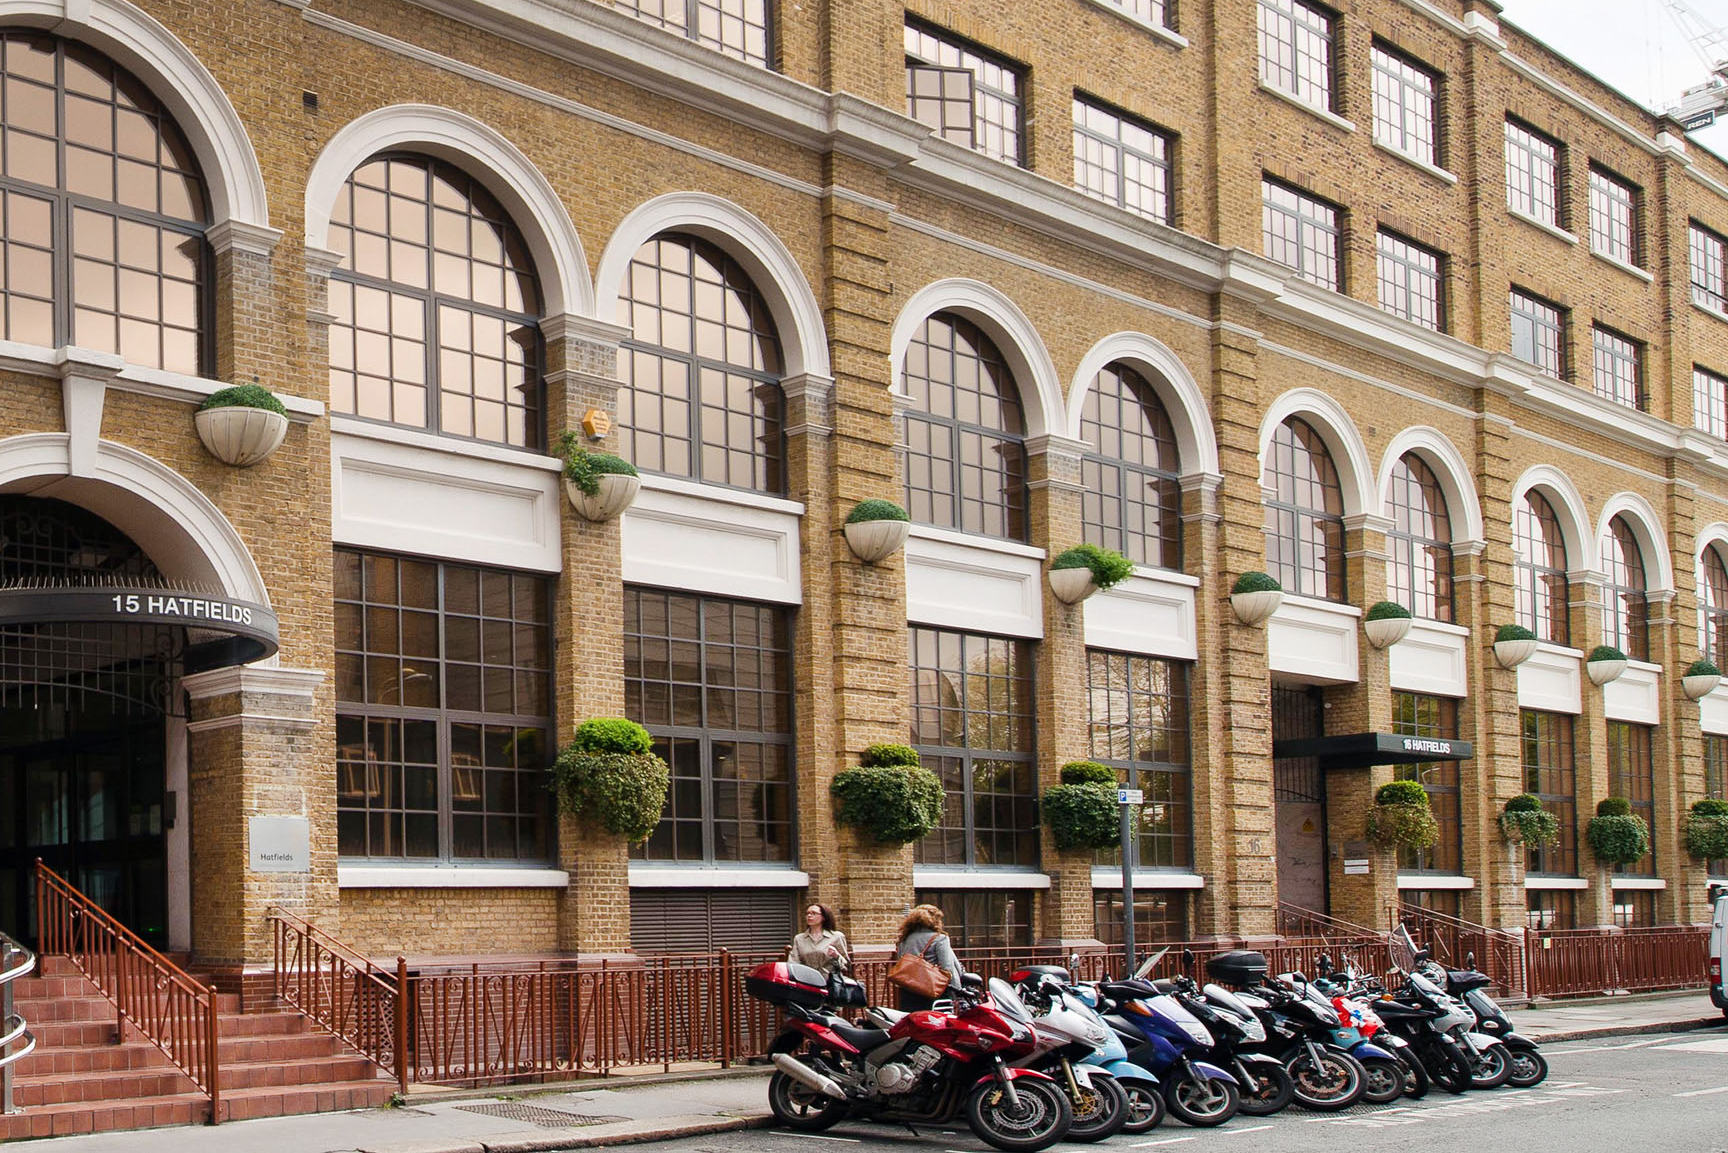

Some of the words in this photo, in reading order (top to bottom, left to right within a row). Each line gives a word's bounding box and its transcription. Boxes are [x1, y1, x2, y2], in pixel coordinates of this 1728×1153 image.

[112, 595, 140, 613] 15
[148, 596, 252, 625] HATFIELDS
[1412, 739, 1451, 754] HATFIELDS
[260, 853, 293, 861] Hatfields
